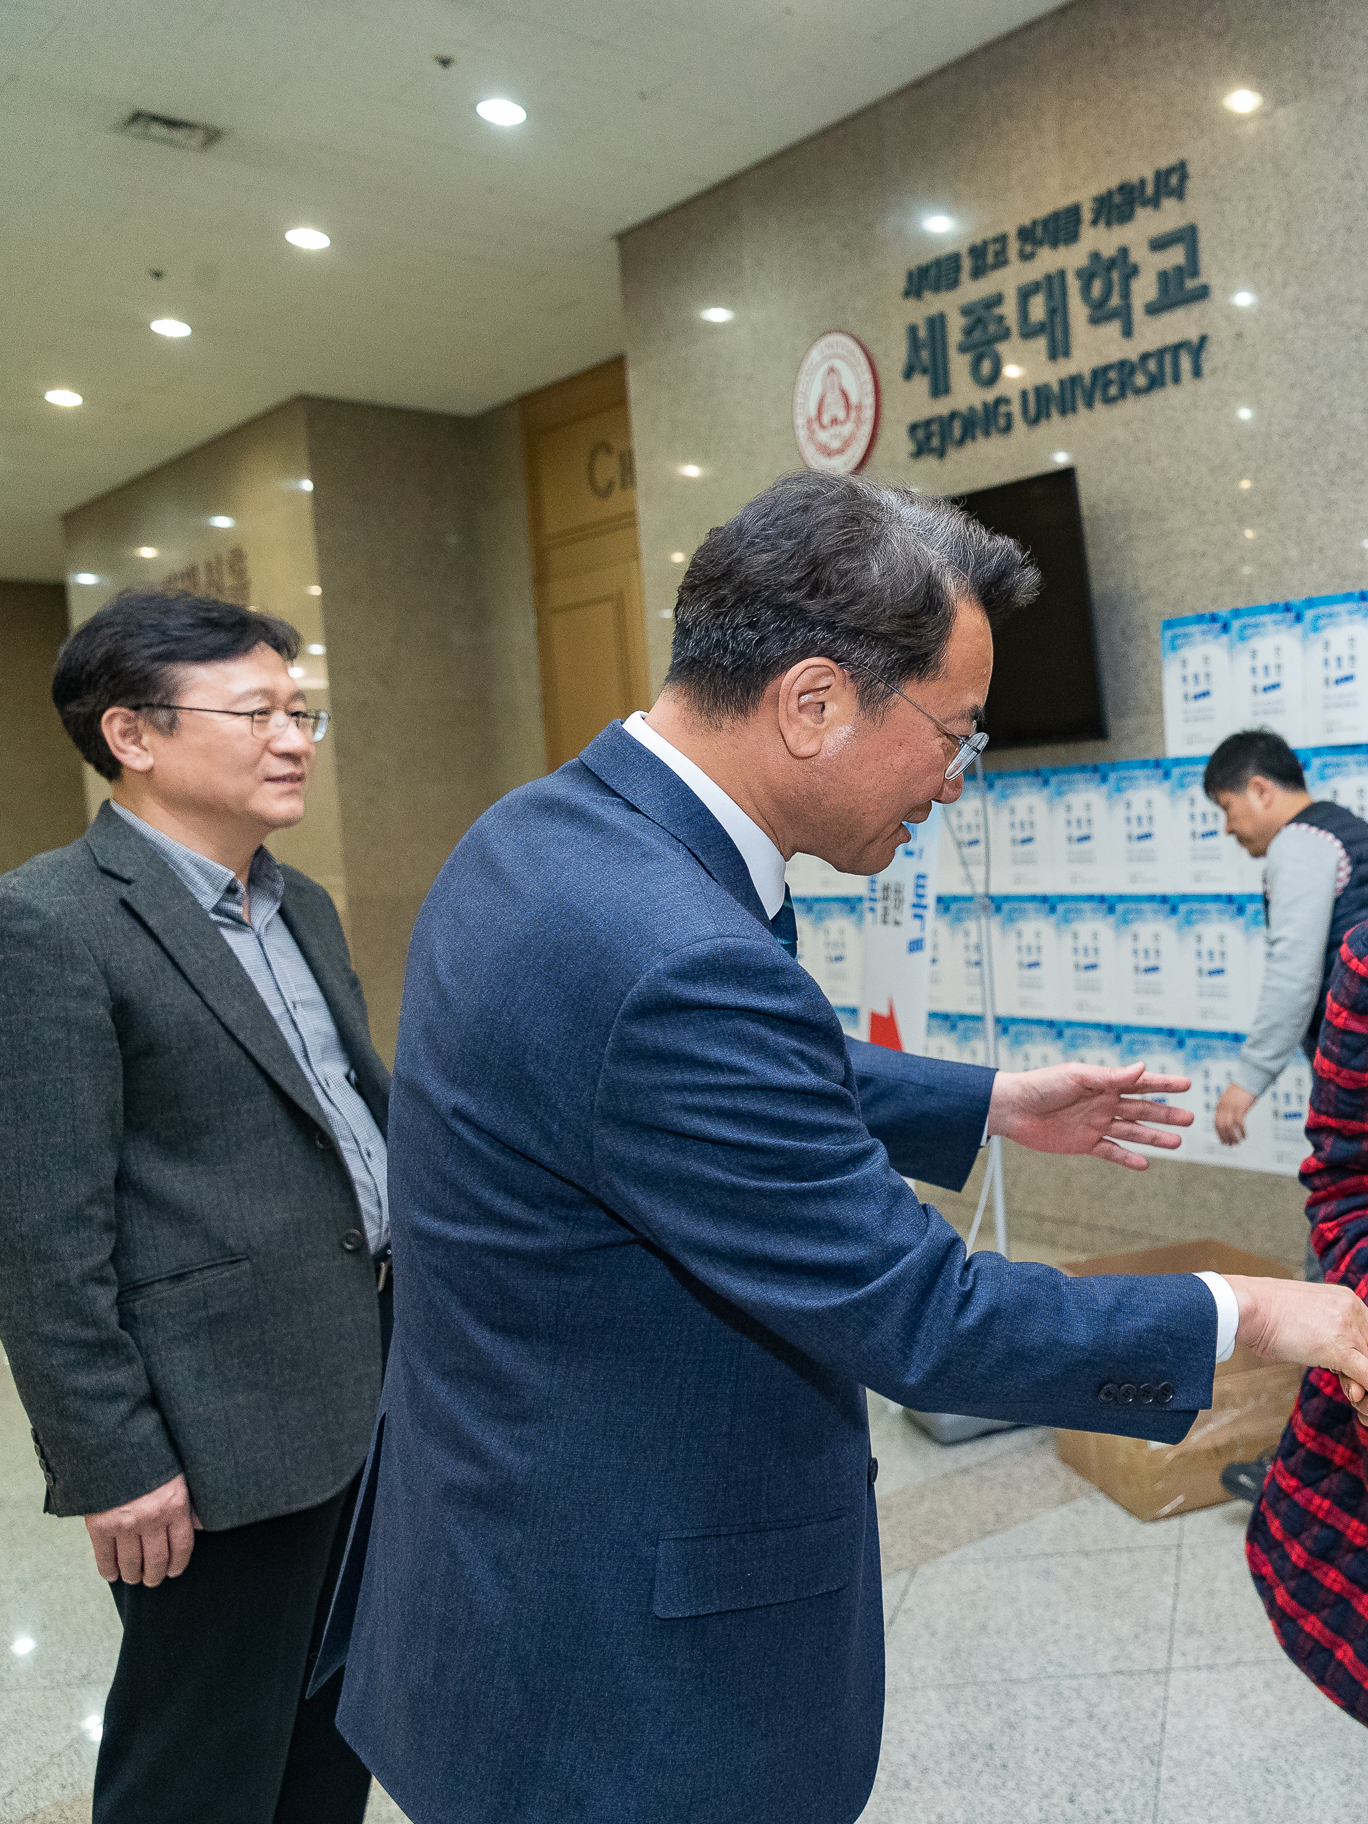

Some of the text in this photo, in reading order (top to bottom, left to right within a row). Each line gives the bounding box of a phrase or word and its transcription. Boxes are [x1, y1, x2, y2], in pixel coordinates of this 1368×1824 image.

[902, 221, 1210, 399] 세종대학교
[907, 394, 1013, 460] SEJONG
[1020, 333, 1208, 427] UNIVERSITY
